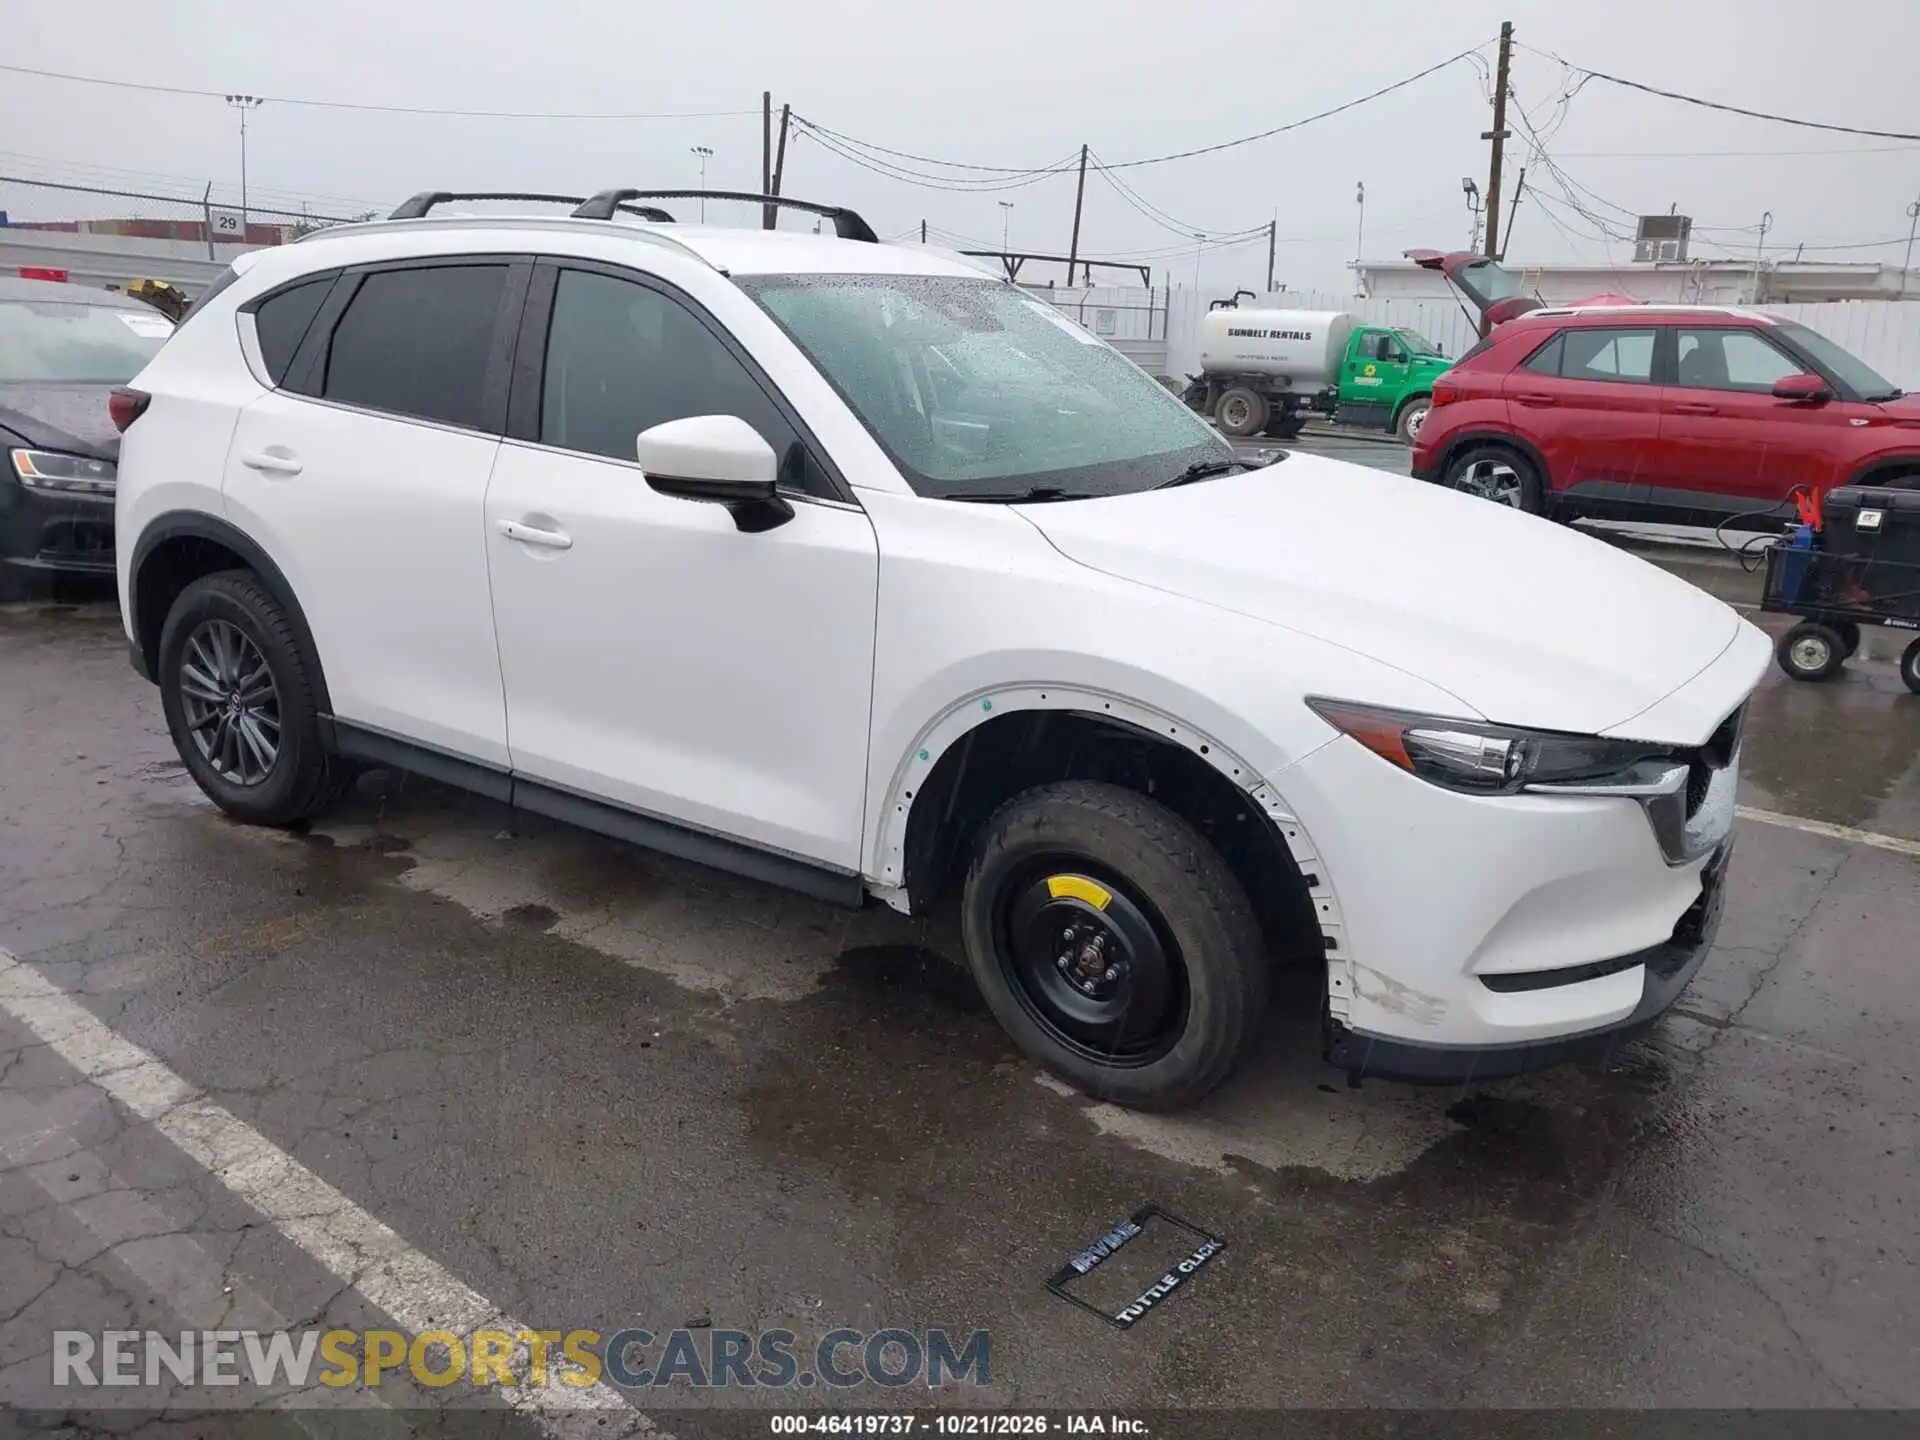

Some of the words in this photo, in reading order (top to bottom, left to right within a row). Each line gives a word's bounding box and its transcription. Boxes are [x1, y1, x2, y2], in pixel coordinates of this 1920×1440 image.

[219, 216, 237, 230] 29
[1227, 328, 1268, 338] SUNBELT
[1269, 330, 1313, 341] RENTALS
[1115, 1273, 1181, 1323] TUTTLE
[1177, 1238, 1225, 1274] CLICK
